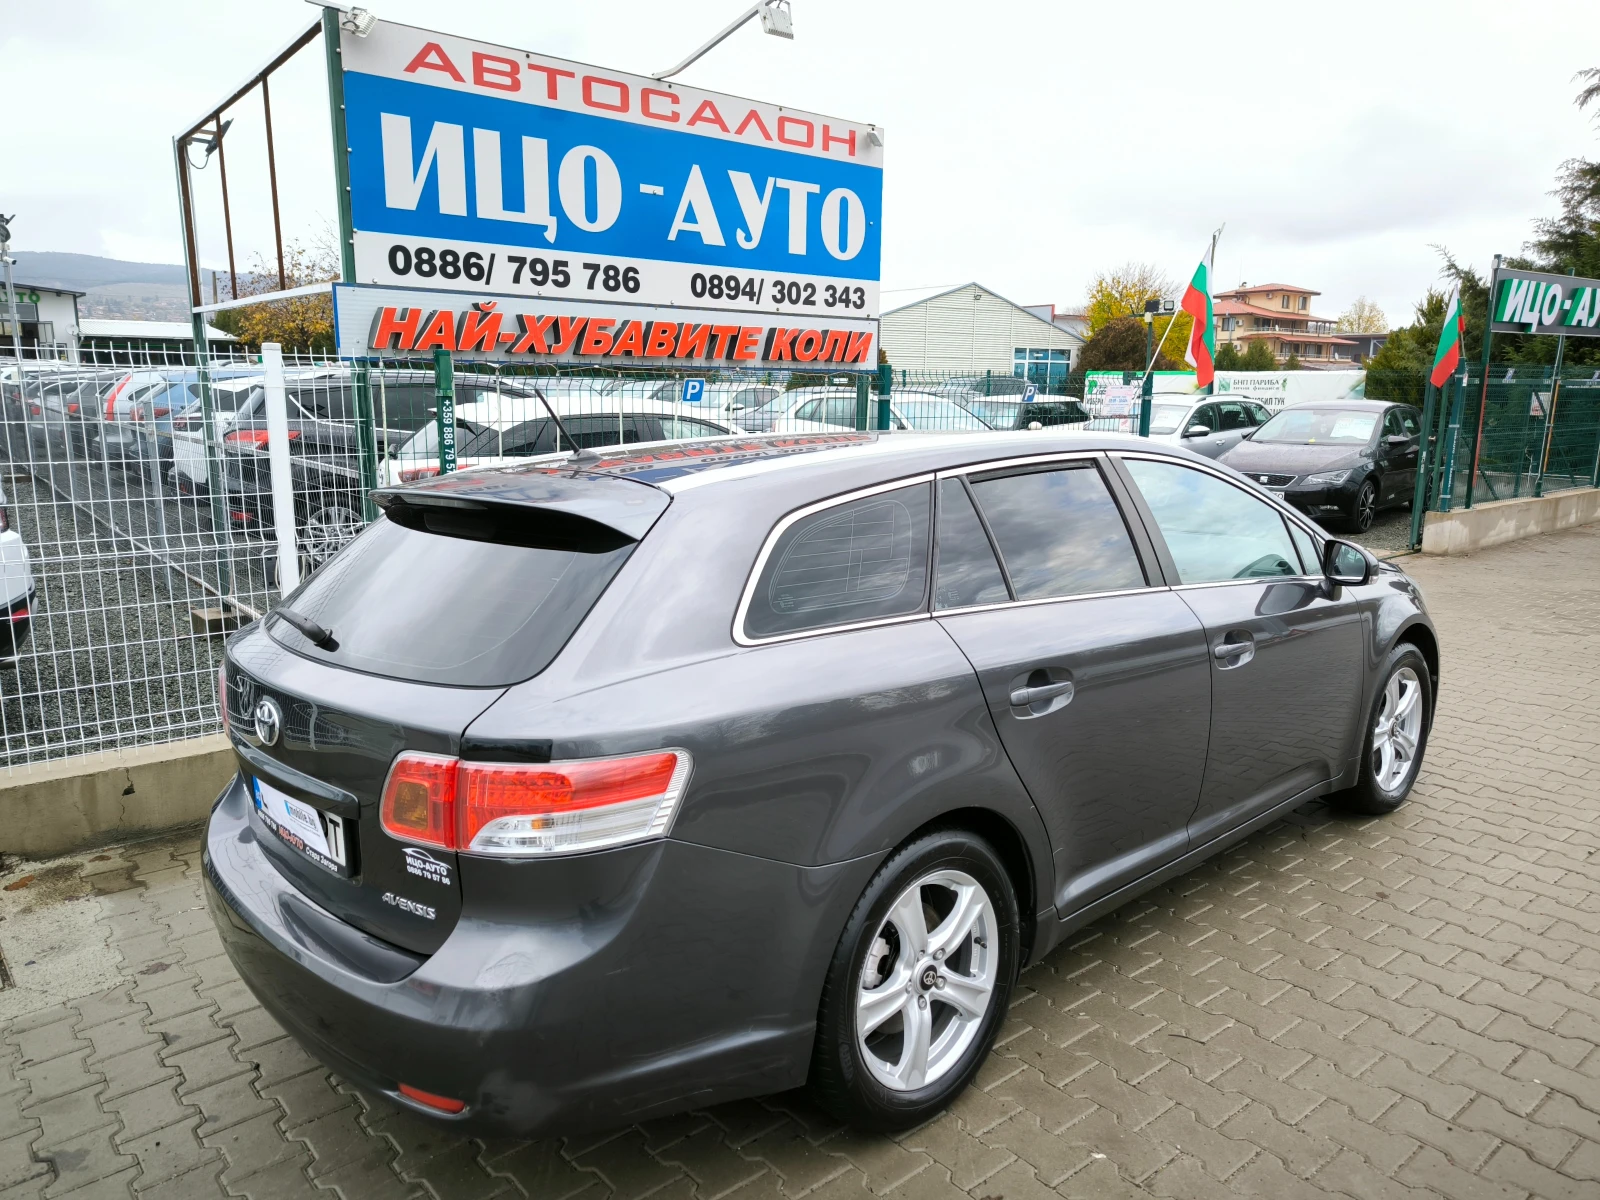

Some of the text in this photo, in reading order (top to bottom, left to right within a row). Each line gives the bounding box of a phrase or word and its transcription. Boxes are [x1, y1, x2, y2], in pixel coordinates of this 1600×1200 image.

[403, 42, 856, 157] АВТОСАЛОН
[387, 244, 641, 294] 0886/ 795 786
[690, 272, 866, 309] 0894/ 302 343
[371, 301, 873, 363] НАЙ-ХУБАВИТЕ КОЛИ
[442, 399, 453, 424] +359
[443, 427, 454, 445] 886
[444, 447, 455, 461] 79
[305, 847, 321, 861] Стара
[320, 853, 338, 872] Загора
[405, 855, 447, 876] ИЦО-АУТО
[381, 892, 437, 920] AVENSIS
